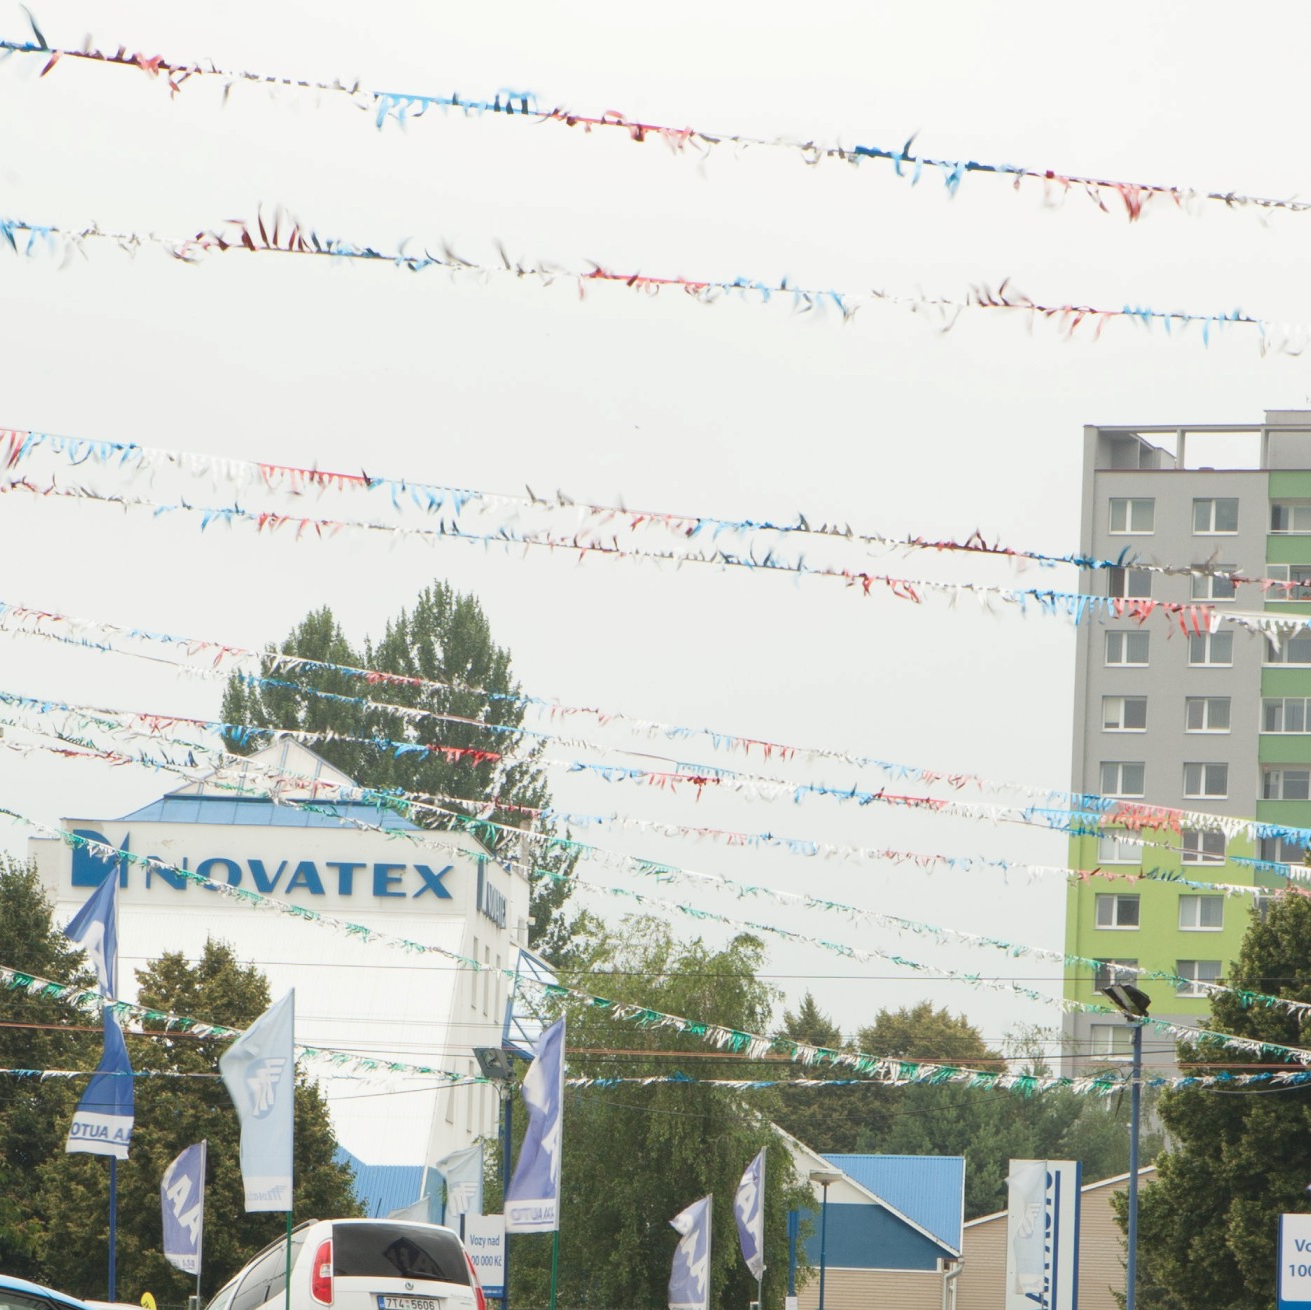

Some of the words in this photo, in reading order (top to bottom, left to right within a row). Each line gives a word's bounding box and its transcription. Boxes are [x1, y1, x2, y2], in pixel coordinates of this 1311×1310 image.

[146, 855, 455, 899] NOVATEX
[470, 1235, 485, 1248] Vozy
[487, 1235, 500, 1246] nad
[472, 1256, 481, 1266] 00
[480, 1256, 494, 1266] 000
[386, 1298, 404, 1308] 7T4
[411, 1299, 435, 1310] 5606
